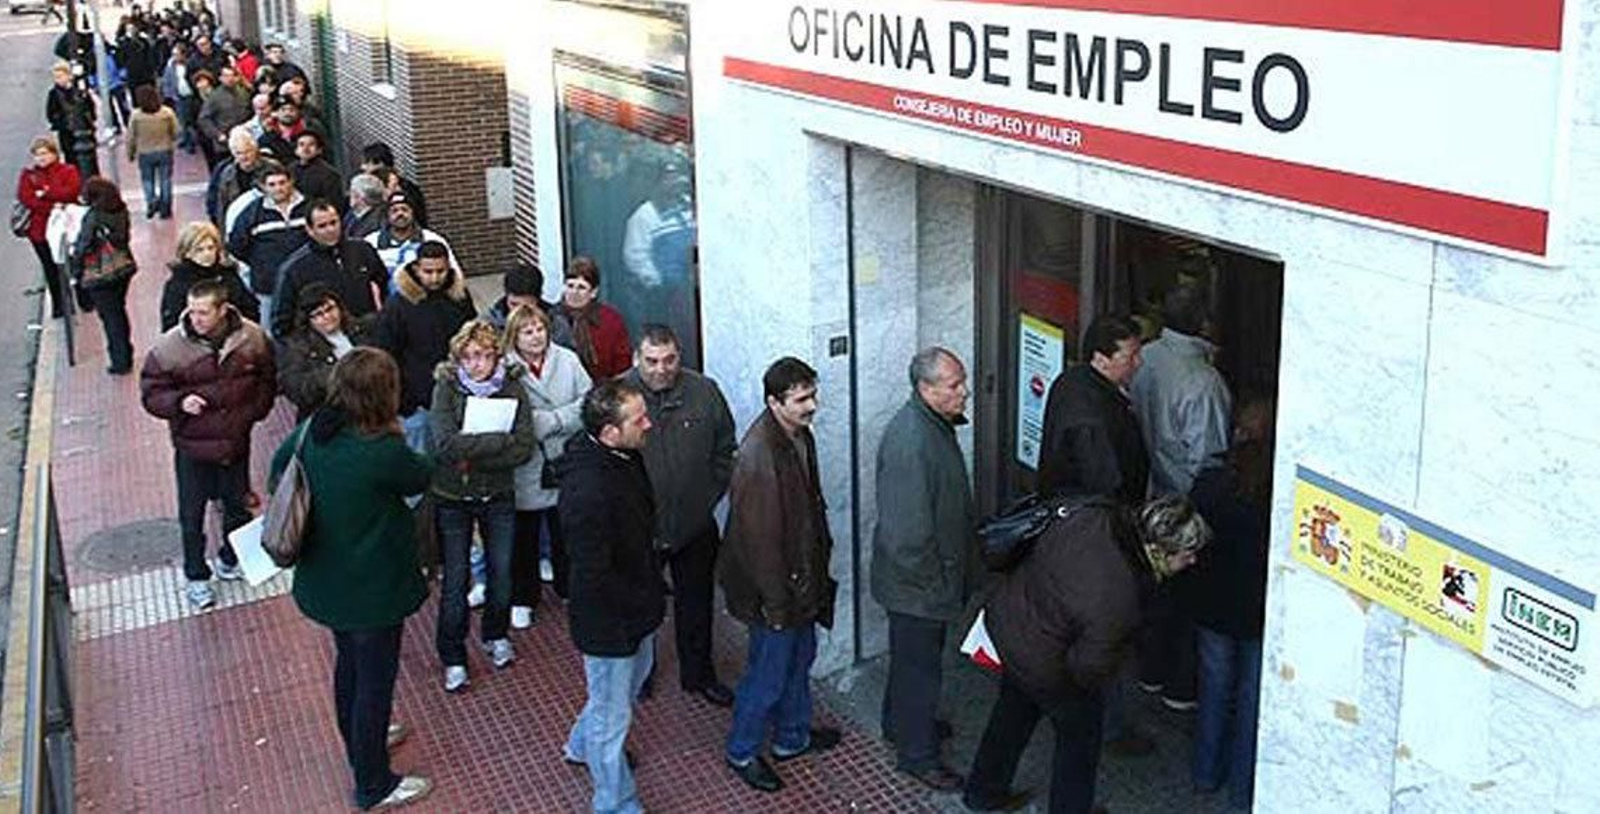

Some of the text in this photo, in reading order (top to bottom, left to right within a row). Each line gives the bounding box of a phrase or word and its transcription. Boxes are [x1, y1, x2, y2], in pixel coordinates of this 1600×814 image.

[788, 5, 1311, 134] OFICINA DE EMPLEO
[957, 107, 973, 124] DE
[973, 111, 1023, 135] EMPLEO
[1023, 121, 1033, 135] Y
[1036, 123, 1082, 147] MUJER
[1421, 600, 1476, 636] SOCIALES
